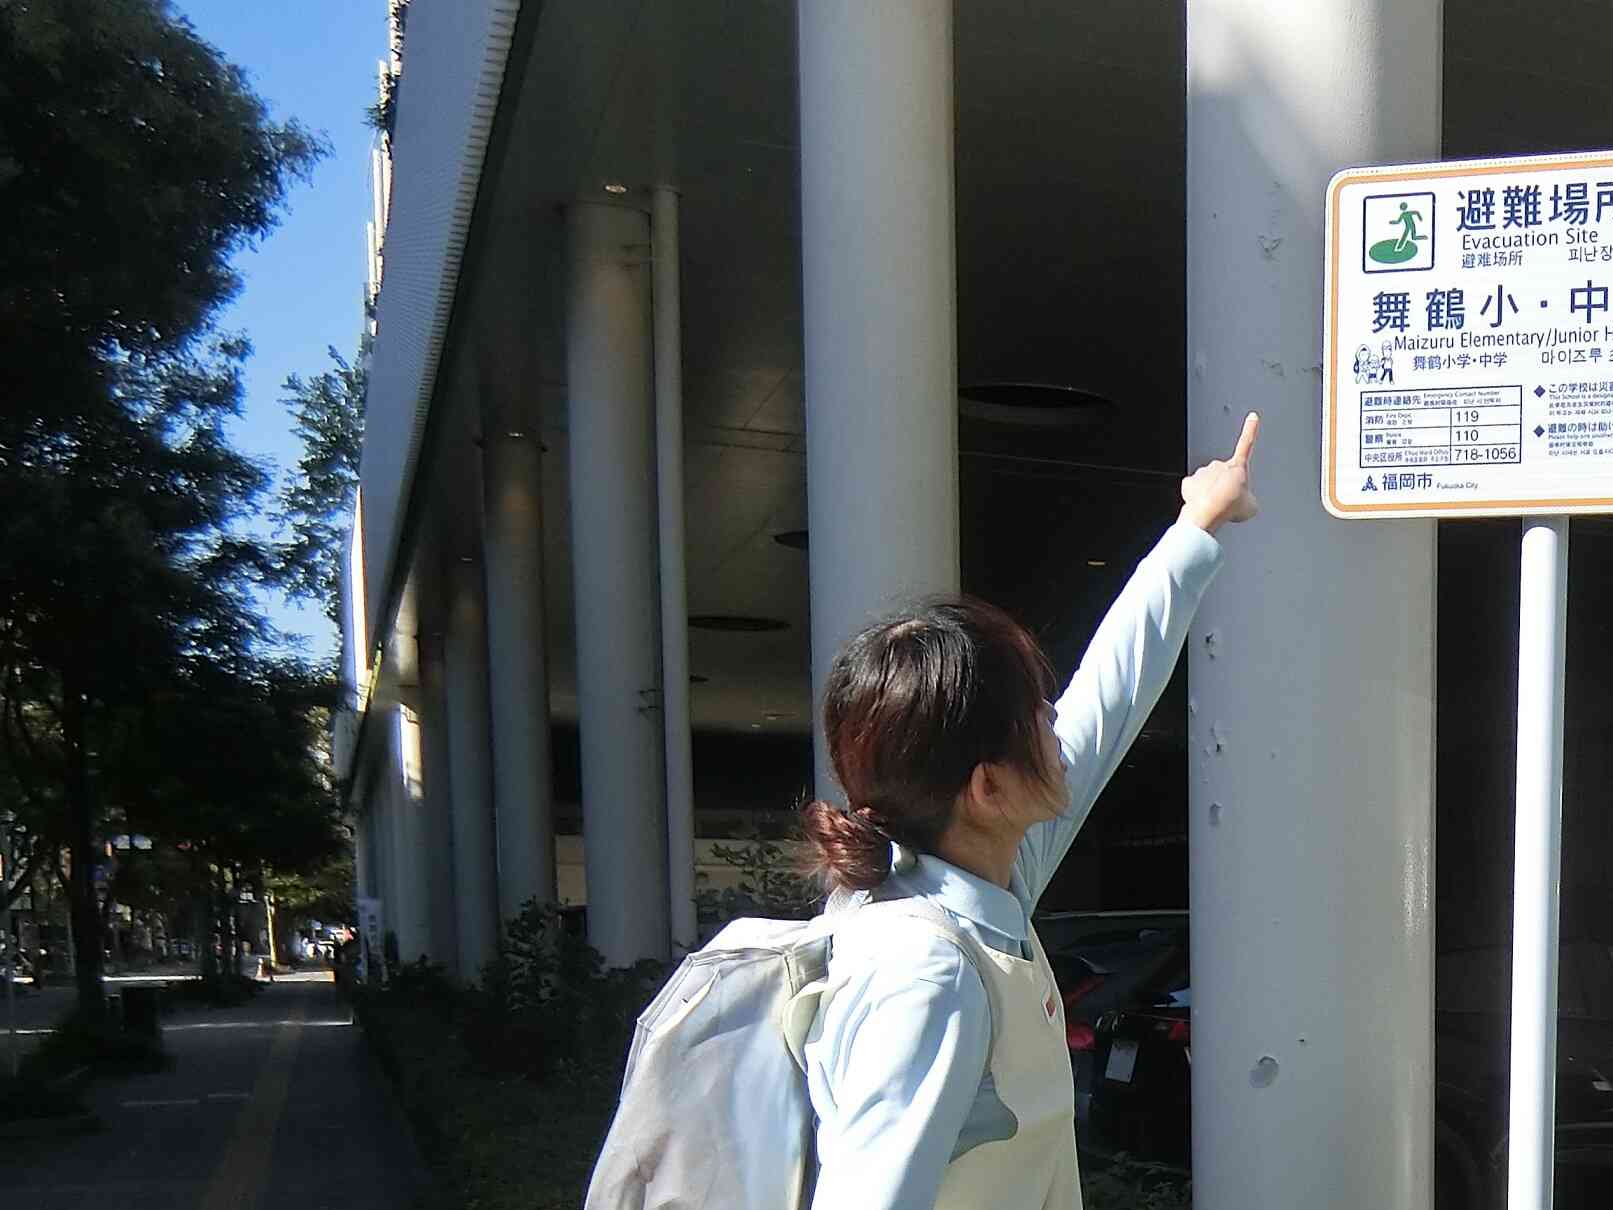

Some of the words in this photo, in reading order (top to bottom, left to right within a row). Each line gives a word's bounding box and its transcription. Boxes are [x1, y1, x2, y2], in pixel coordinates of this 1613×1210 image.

[1462, 231, 1559, 250] Evacuation
[1565, 227, 1599, 245] Site
[1394, 335, 1455, 351] Maizuru
[1460, 327, 1599, 349] Elementary/Junior
[1541, 348, 1603, 365] 마이즈루
[1456, 410, 1479, 423] 119
[1456, 429, 1479, 442] 110
[1455, 447, 1517, 462] 718-1056
[1382, 471, 1433, 491] 福岡市
